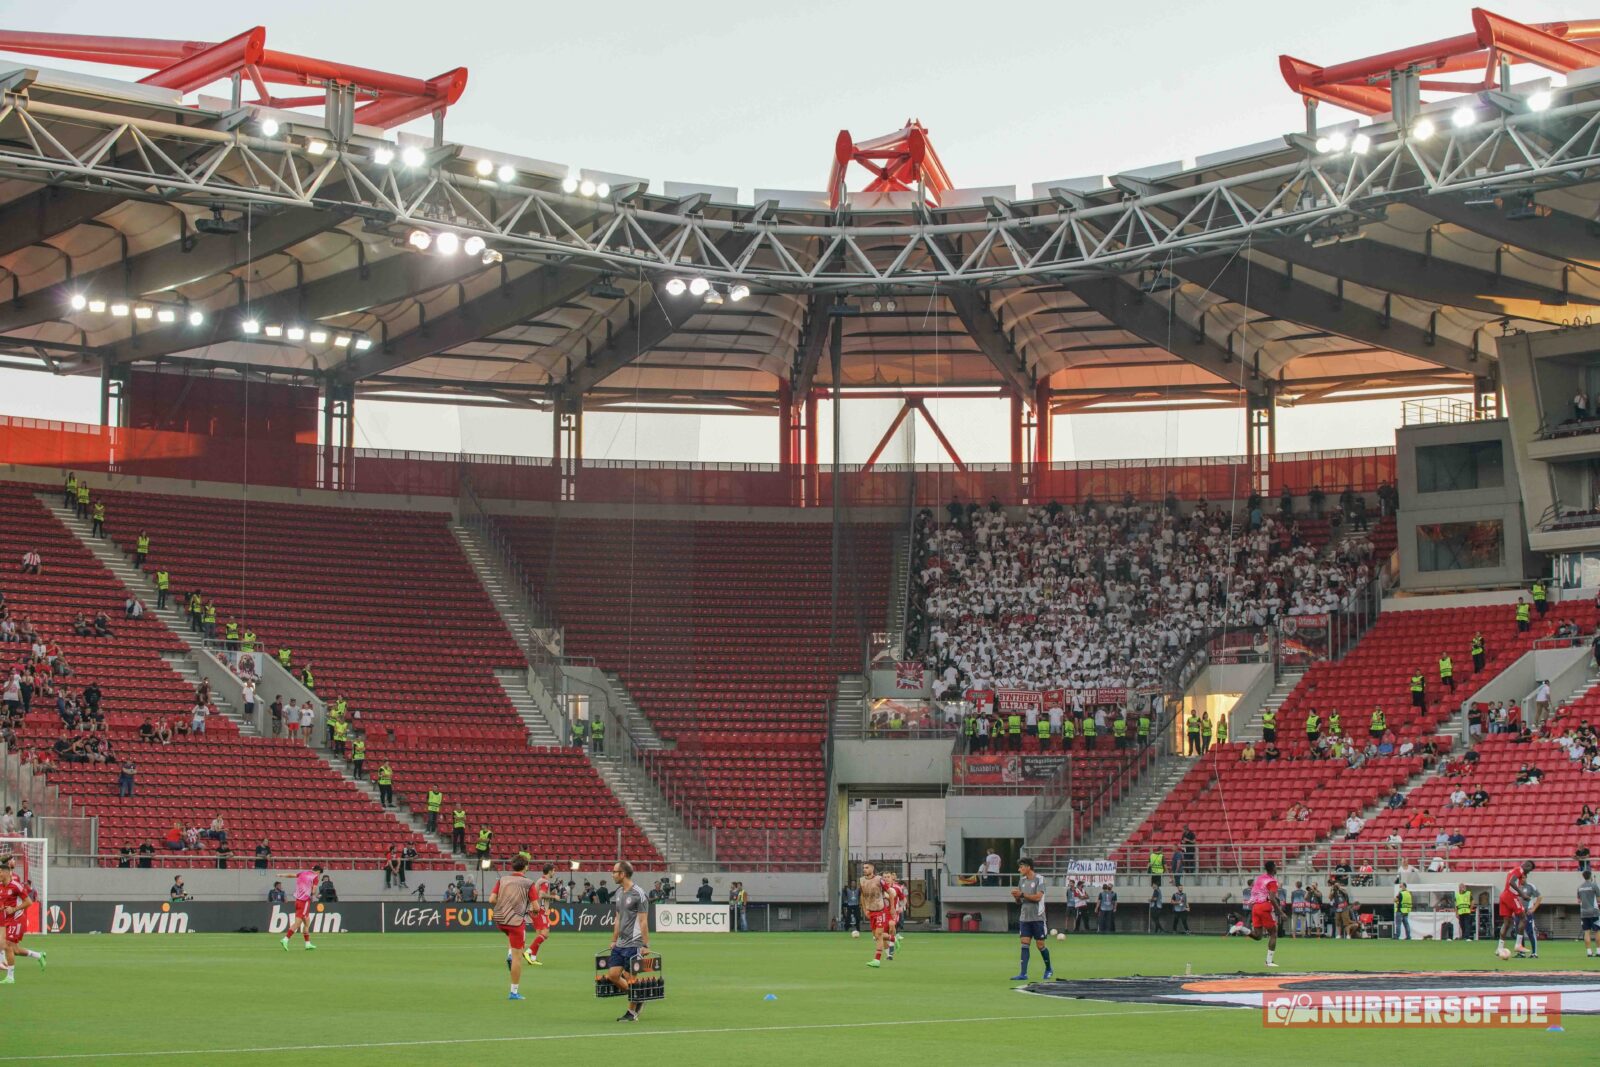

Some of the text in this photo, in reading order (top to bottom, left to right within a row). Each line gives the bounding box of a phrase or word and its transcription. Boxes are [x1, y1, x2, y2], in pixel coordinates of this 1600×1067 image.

[111, 902, 189, 933] bwin
[394, 908, 441, 926] UEFA
[578, 908, 597, 931] for
[676, 912, 727, 925] RESPECT
